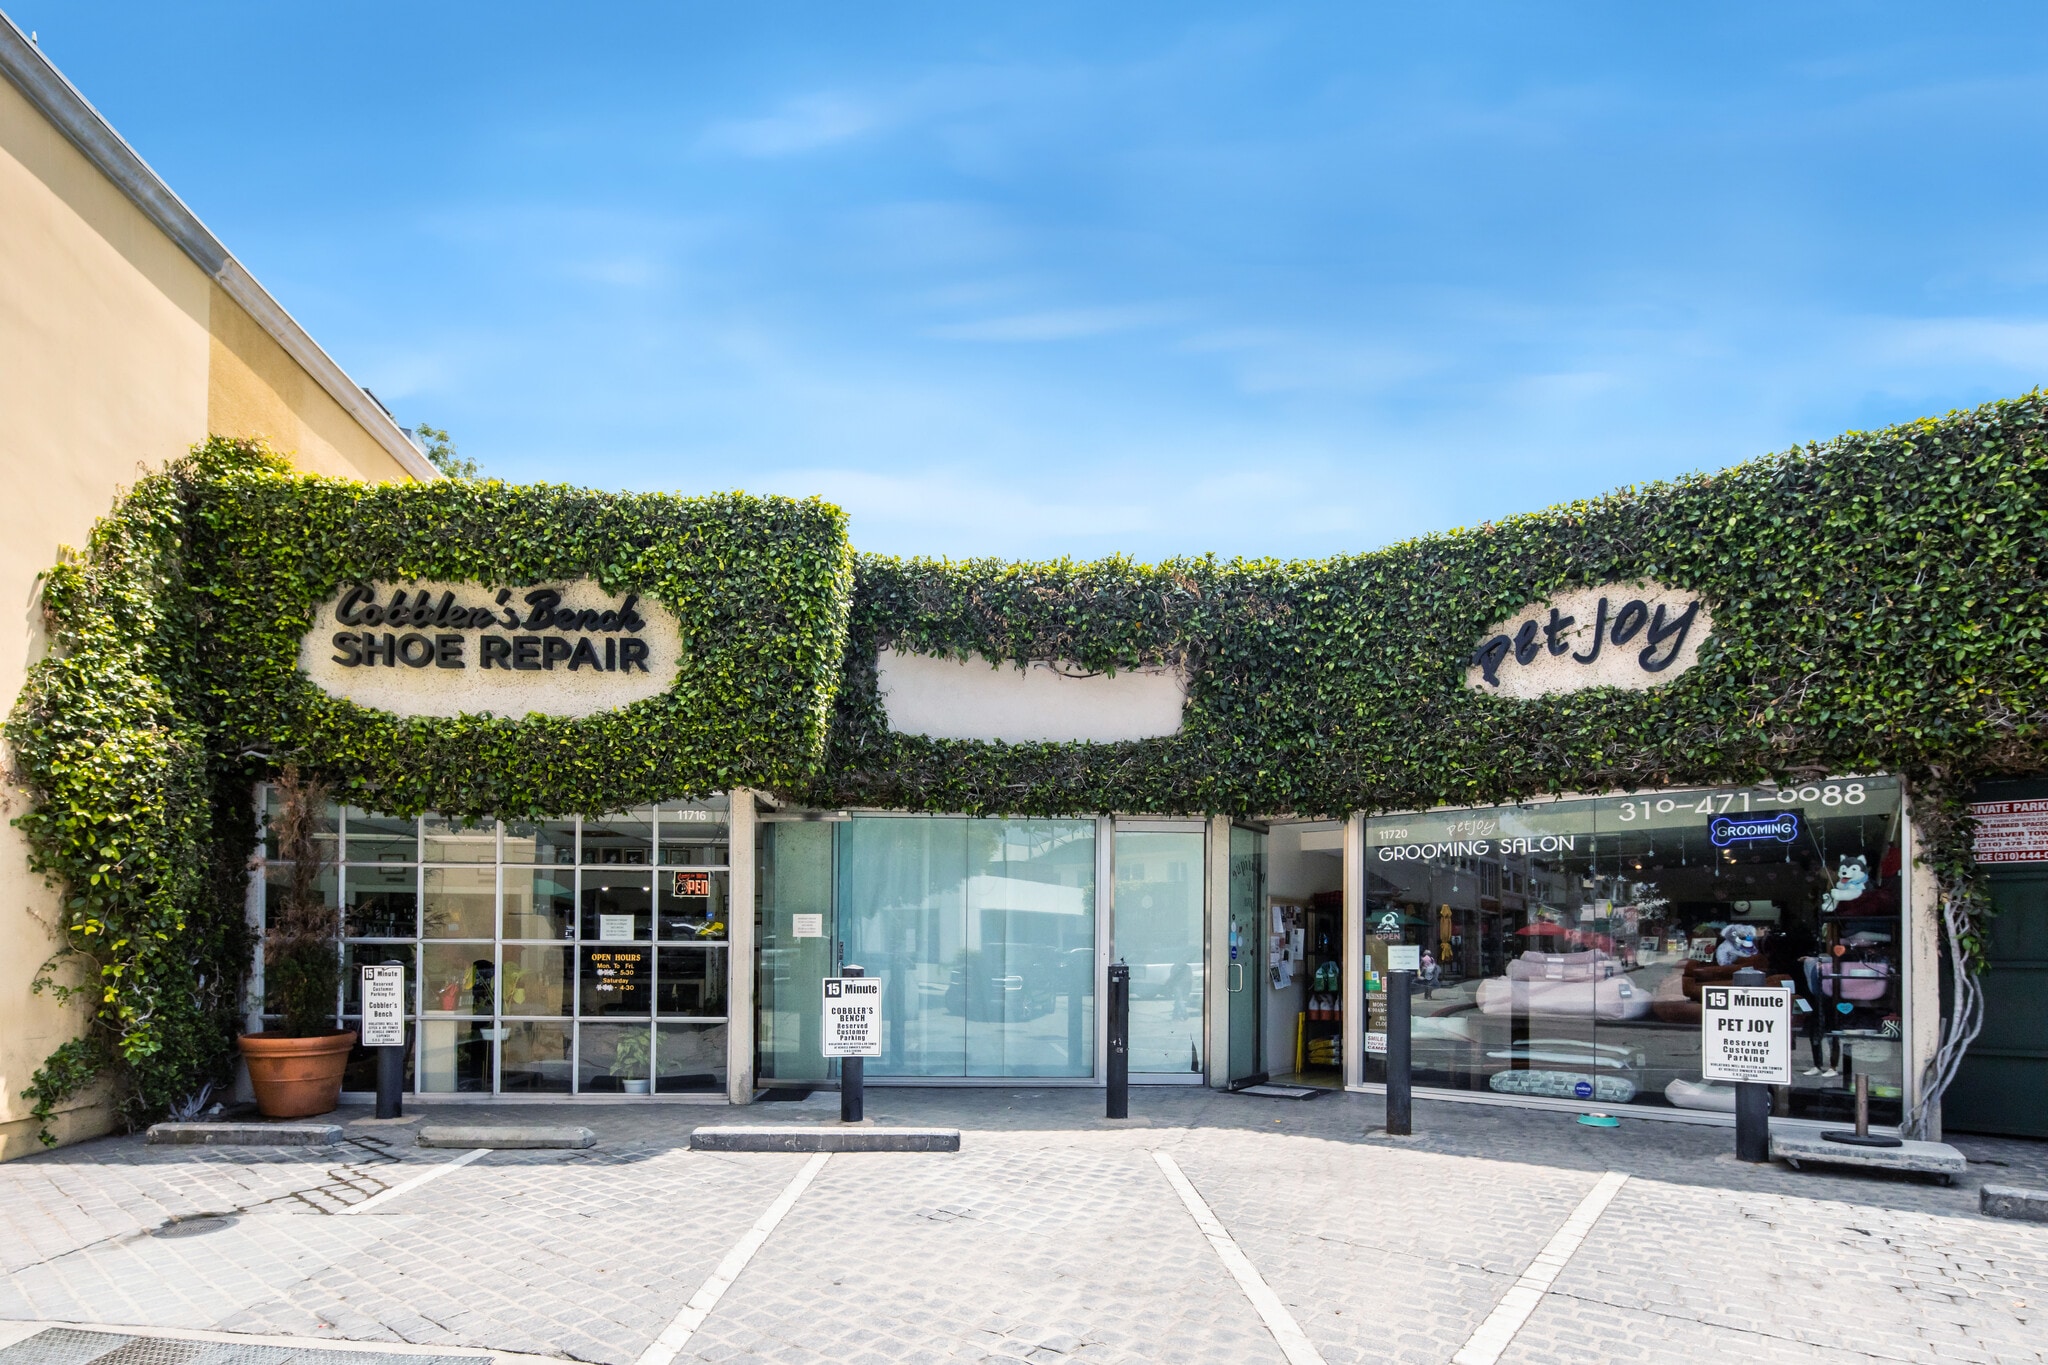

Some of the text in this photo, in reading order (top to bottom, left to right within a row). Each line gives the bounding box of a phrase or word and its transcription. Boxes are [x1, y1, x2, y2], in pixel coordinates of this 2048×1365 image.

[335, 586, 646, 633] Cobbler's Bench
[331, 632, 650, 673] SHOE REPAIR
[1971, 804, 2010, 814] IVATE
[677, 810, 706, 820] 11716
[1379, 829, 1408, 839] 11720
[1717, 823, 1792, 837] GROOMING
[1378, 835, 1574, 862] GROOMING SALON
[365, 969, 374, 979] 15
[826, 983, 878, 996] 15 Minute
[1708, 992, 1783, 1007] 15 Minute
[831, 1007, 873, 1015] COBBLER'S
[1718, 1018, 1774, 1033] PET JOY
[1723, 1038, 1769, 1047] Reserved
[1723, 1046, 1769, 1055] Customer
[1728, 1054, 1765, 1063] Parking
